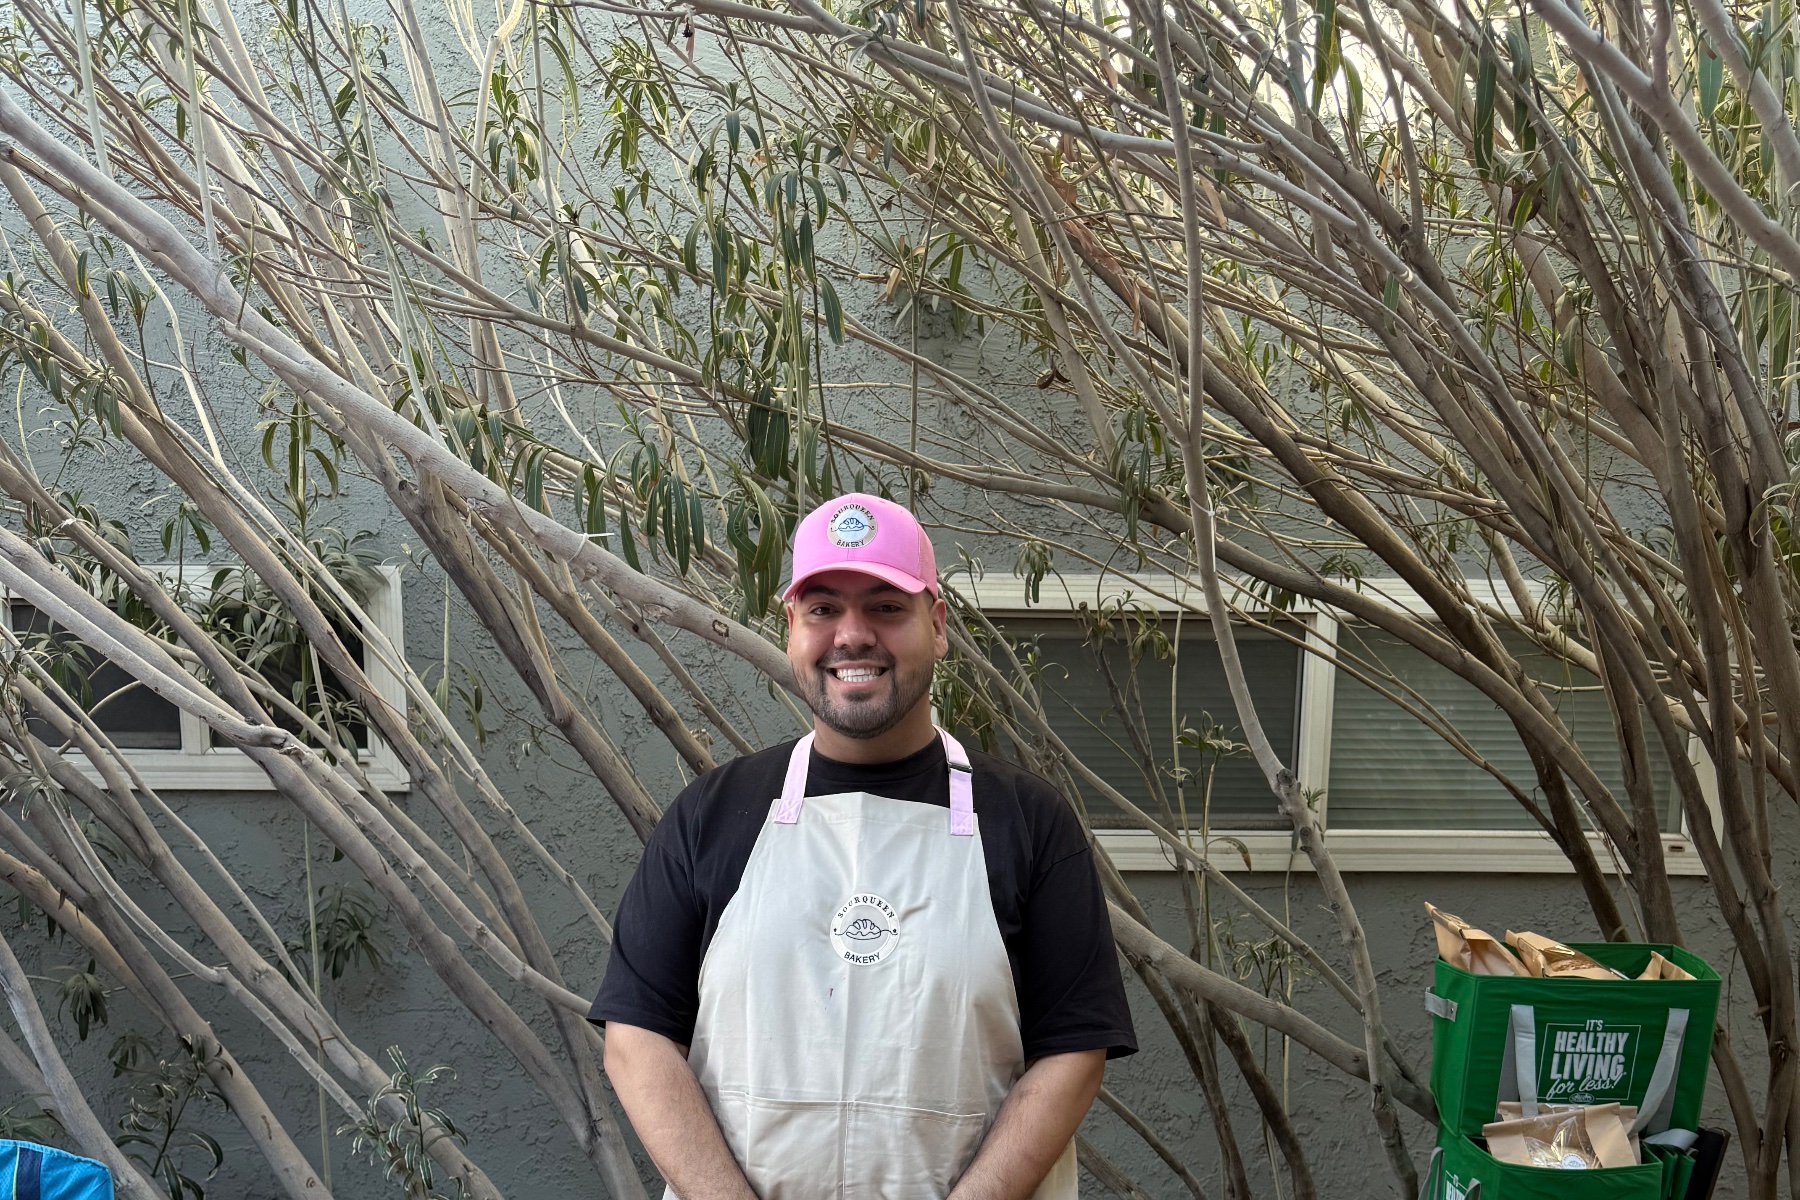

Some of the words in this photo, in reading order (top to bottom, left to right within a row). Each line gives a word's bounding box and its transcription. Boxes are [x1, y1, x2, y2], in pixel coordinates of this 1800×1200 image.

[836, 539, 865, 548] BAKERY
[838, 895, 895, 918] SOURQUEEN
[844, 951, 881, 964] BAKERY
[1585, 1019, 1604, 1032] IT'S
[1554, 1031, 1630, 1054] HEALTHY
[1550, 1053, 1626, 1081] LIVING
[1545, 1078, 1575, 1101] for
